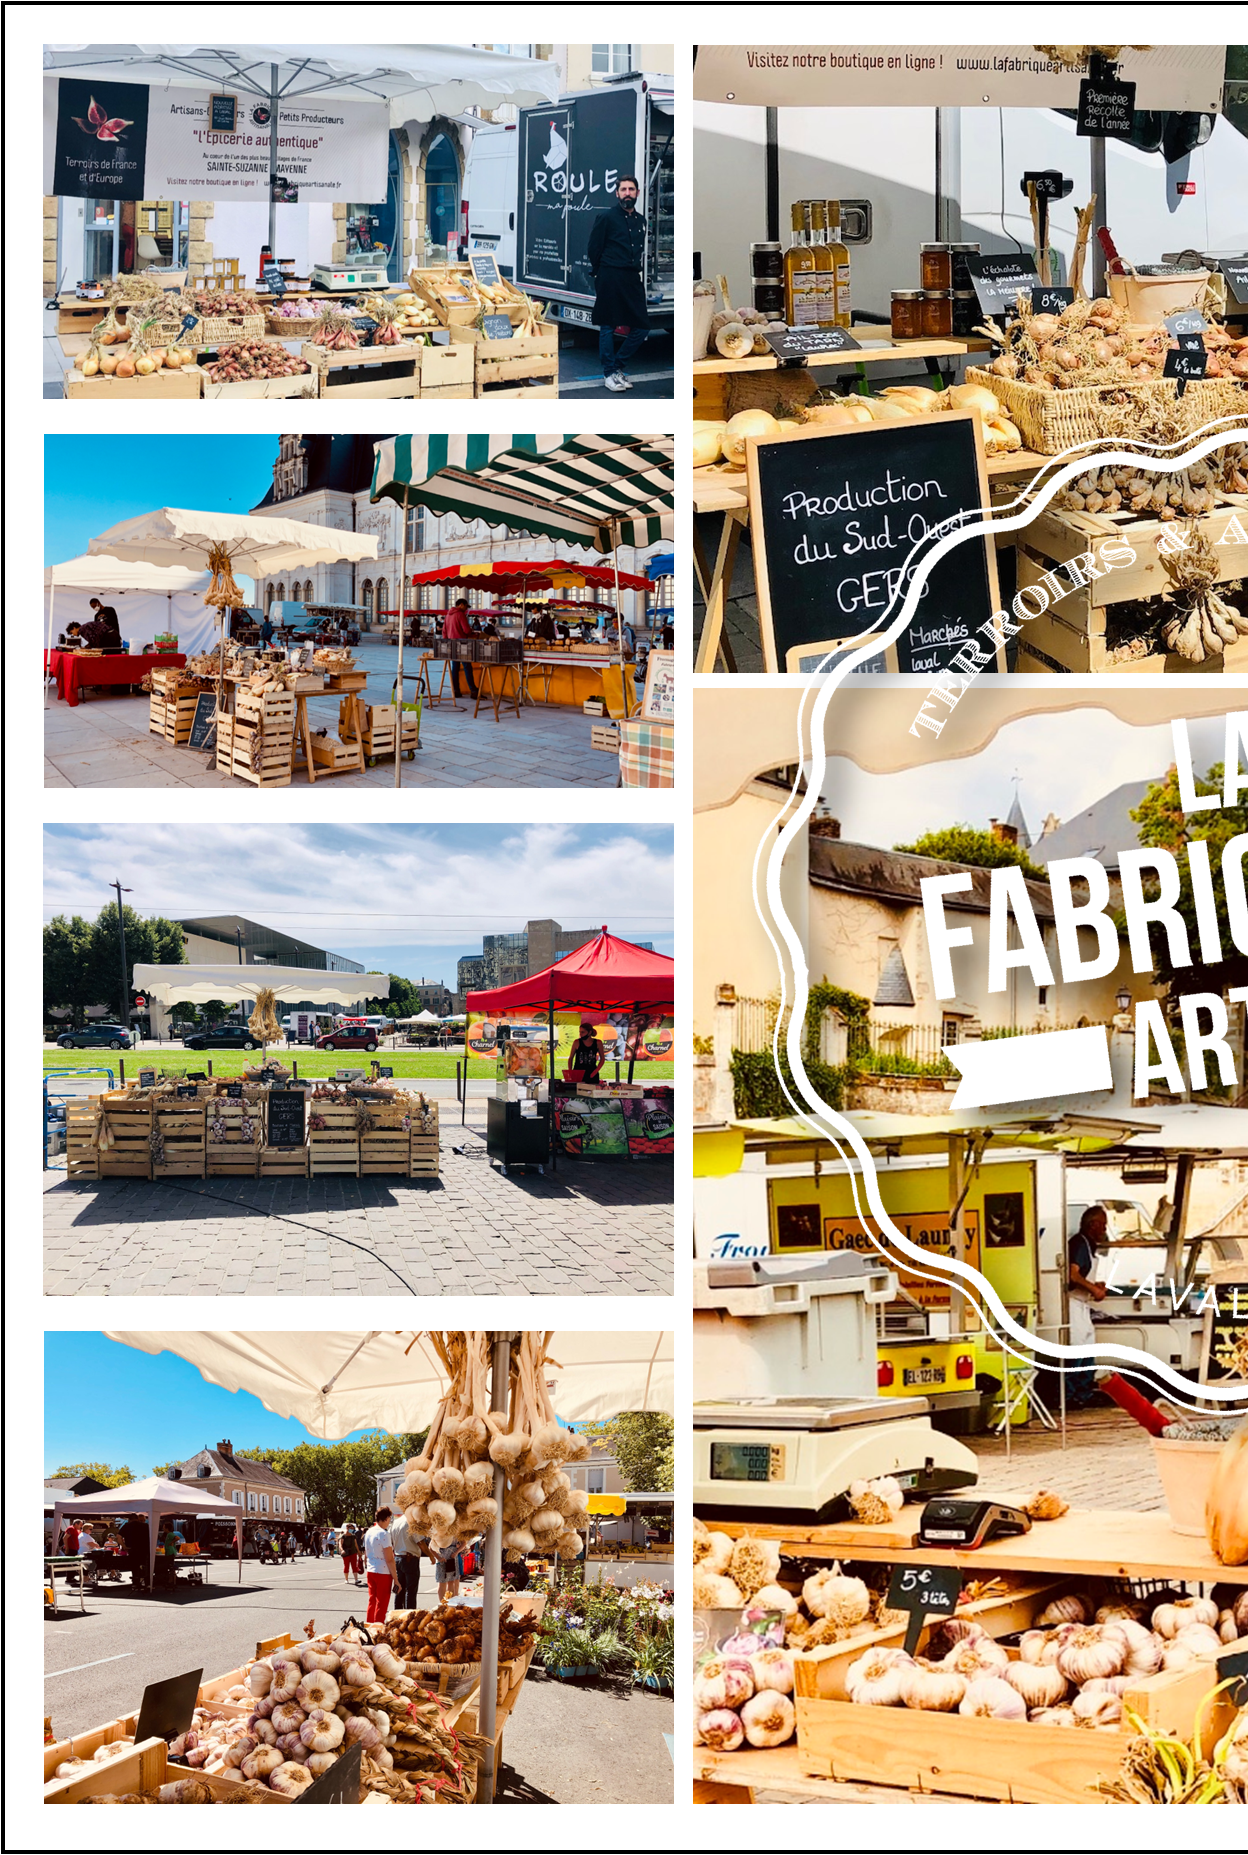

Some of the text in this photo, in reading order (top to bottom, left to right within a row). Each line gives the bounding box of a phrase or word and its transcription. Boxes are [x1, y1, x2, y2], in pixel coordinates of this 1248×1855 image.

[747, 51, 936, 72] Visitez notre boutique en ligne
[279, 112, 344, 124] Petits Producteurs
[1084, 116, 1098, 128] de
[255, 134, 324, 150] autentique"
[65, 156, 138, 170] Terroirs de France
[207, 162, 268, 173] SAINTE-SUZANNE
[79, 172, 123, 185] et d'Europe
[533, 169, 618, 193] ROULE
[783, 469, 947, 520] Production
[794, 534, 837, 565] du
[900, 1569, 933, 1591] 5€
